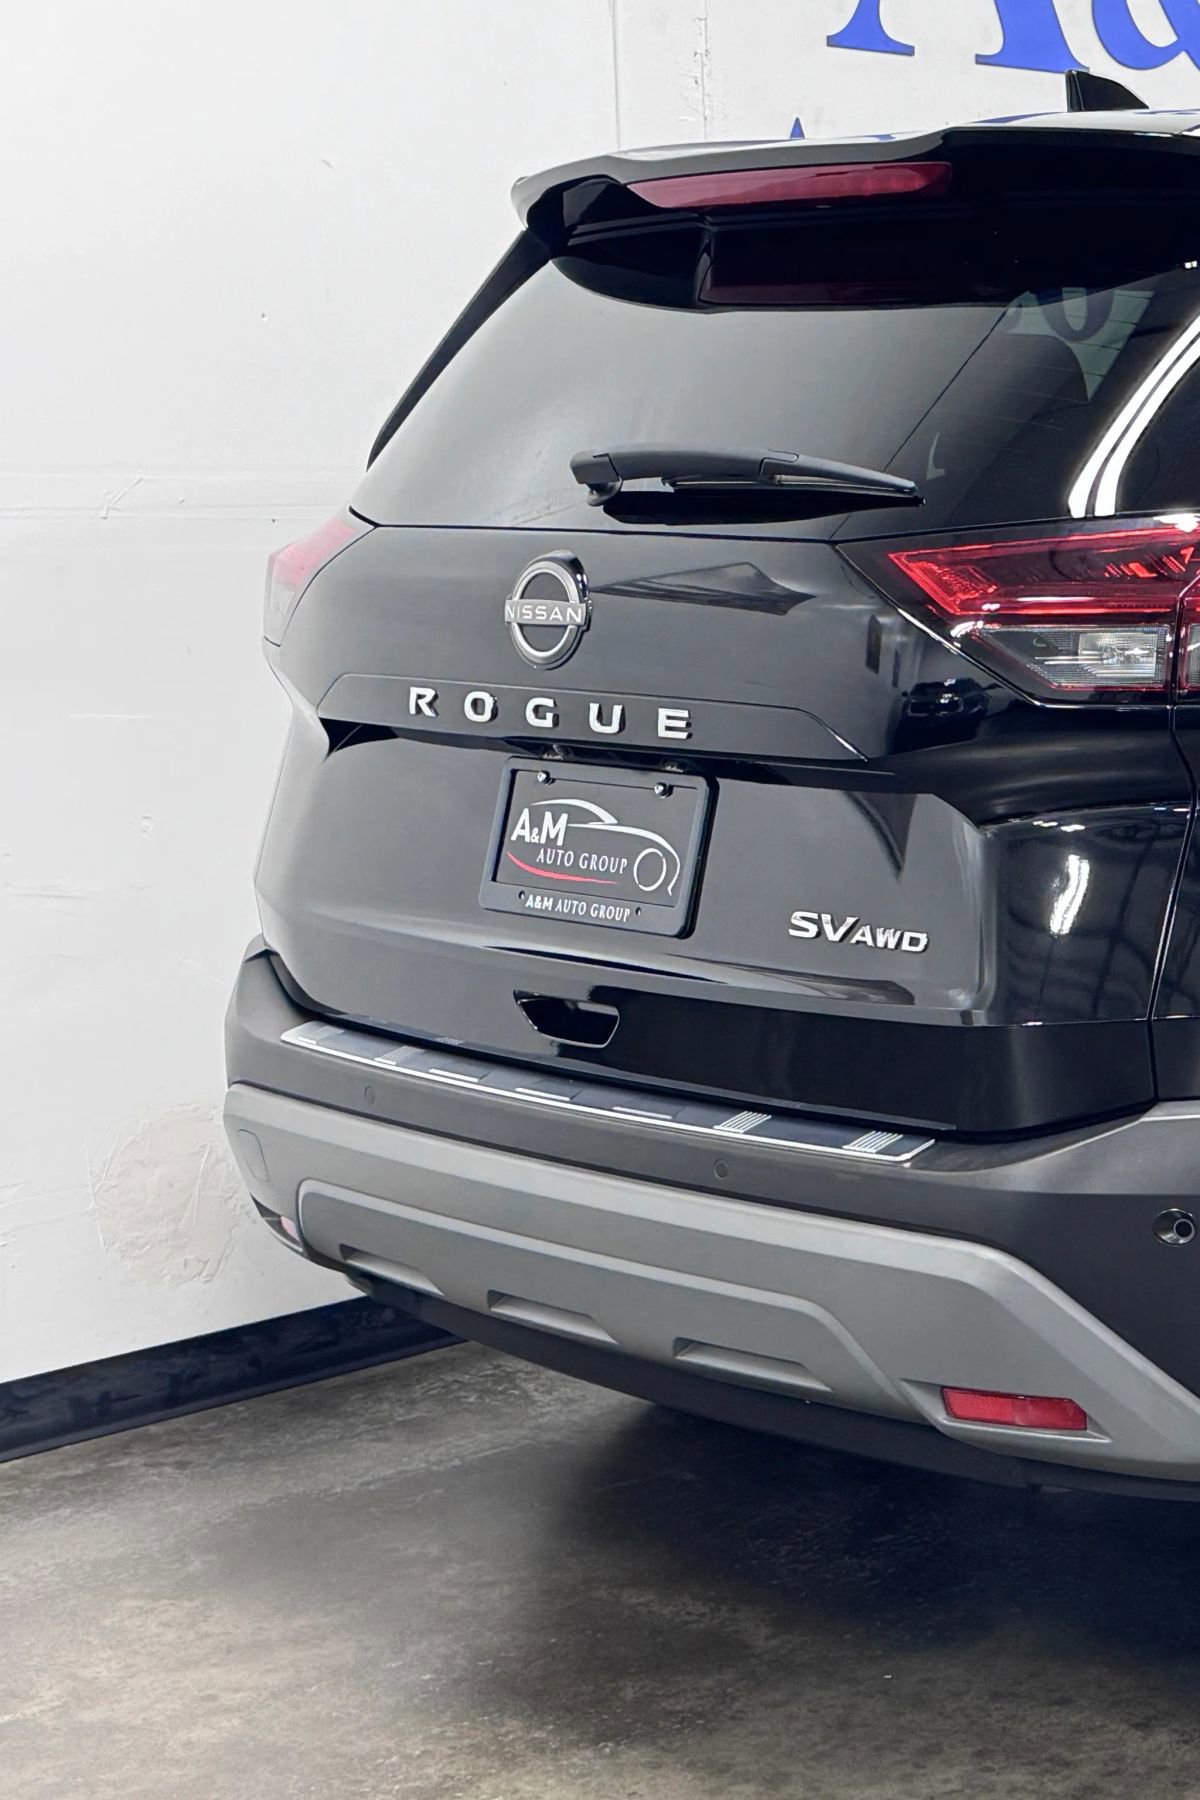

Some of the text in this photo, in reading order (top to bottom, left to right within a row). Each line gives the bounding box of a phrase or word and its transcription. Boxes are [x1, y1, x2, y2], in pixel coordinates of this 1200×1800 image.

[504, 603, 583, 624] NISSAN
[408, 686, 693, 740] ROGUE
[510, 807, 569, 846] A&M
[536, 848, 628, 874] AUTO GROUP
[525, 893, 631, 922] A&M AUTO GROUP
[788, 910, 928, 952] SV AWD
